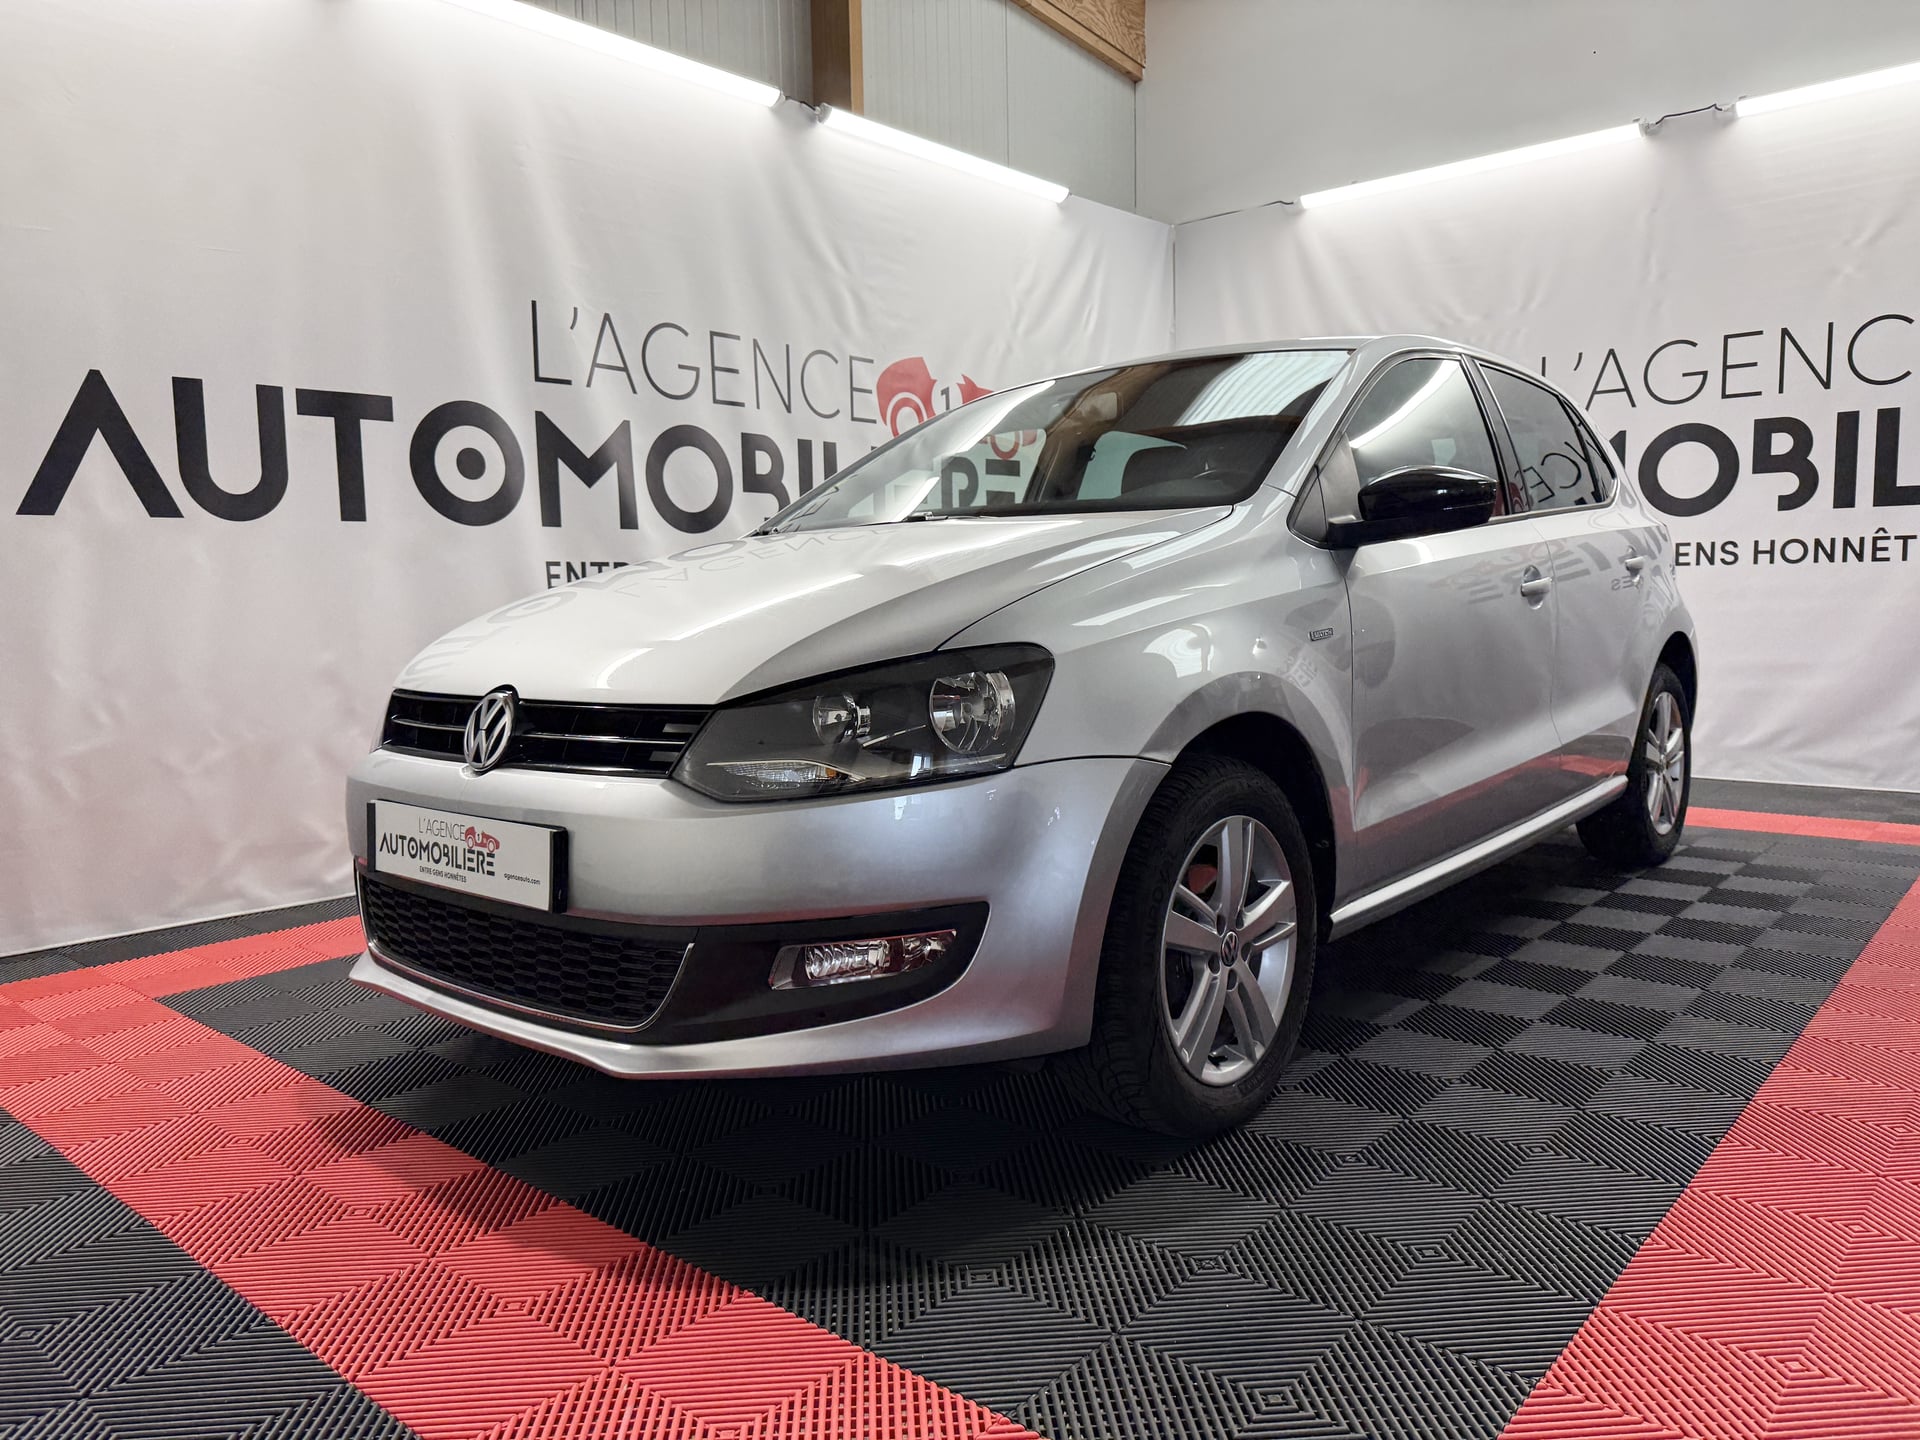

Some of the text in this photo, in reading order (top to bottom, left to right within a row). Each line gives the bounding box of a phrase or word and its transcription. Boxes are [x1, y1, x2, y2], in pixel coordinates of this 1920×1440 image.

[531, 300, 877, 424] L'AGENCE
[1753, 527, 1917, 565] HONNÊT
[418, 816, 466, 841] L'AGENCE
